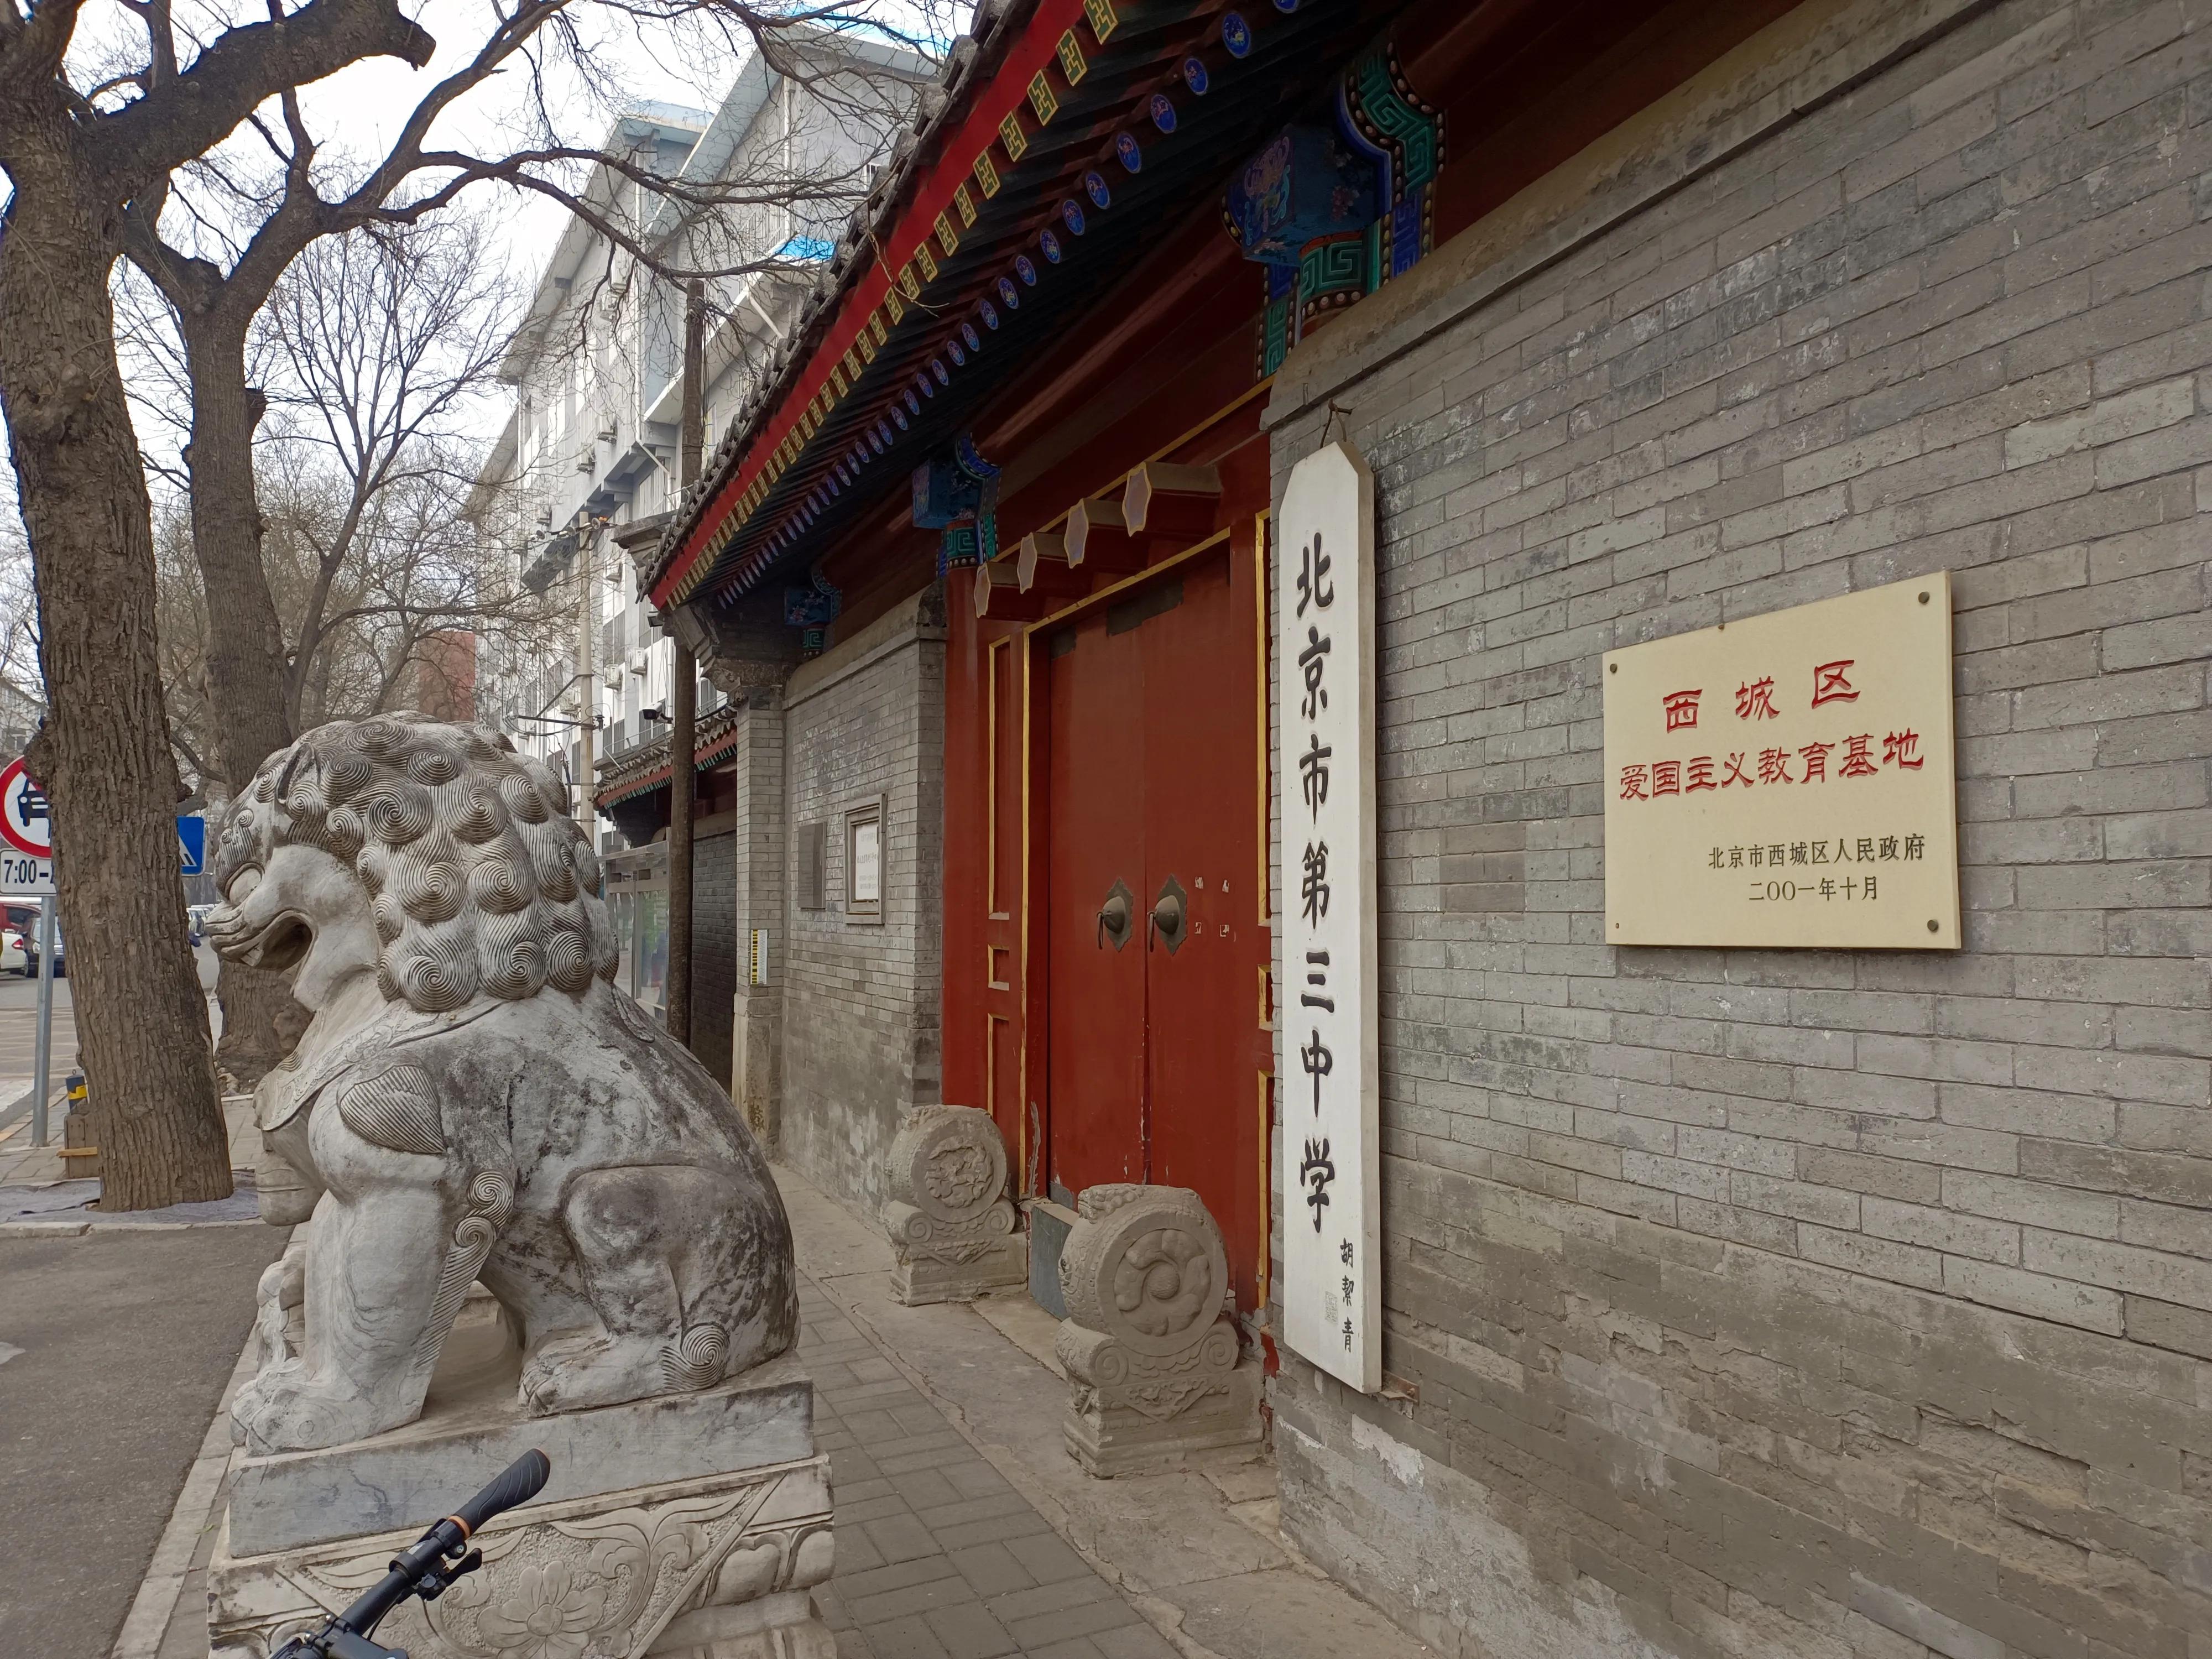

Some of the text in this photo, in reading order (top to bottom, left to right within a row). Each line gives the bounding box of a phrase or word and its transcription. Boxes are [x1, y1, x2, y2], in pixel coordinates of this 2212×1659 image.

[1662, 660, 1861, 733] 西城区
[1620, 728, 1924, 801] 爱国主义教育基地
[1296, 532, 1335, 1234] 北京市第三中学
[1708, 833, 1926, 870] 北京市西城区人民政府
